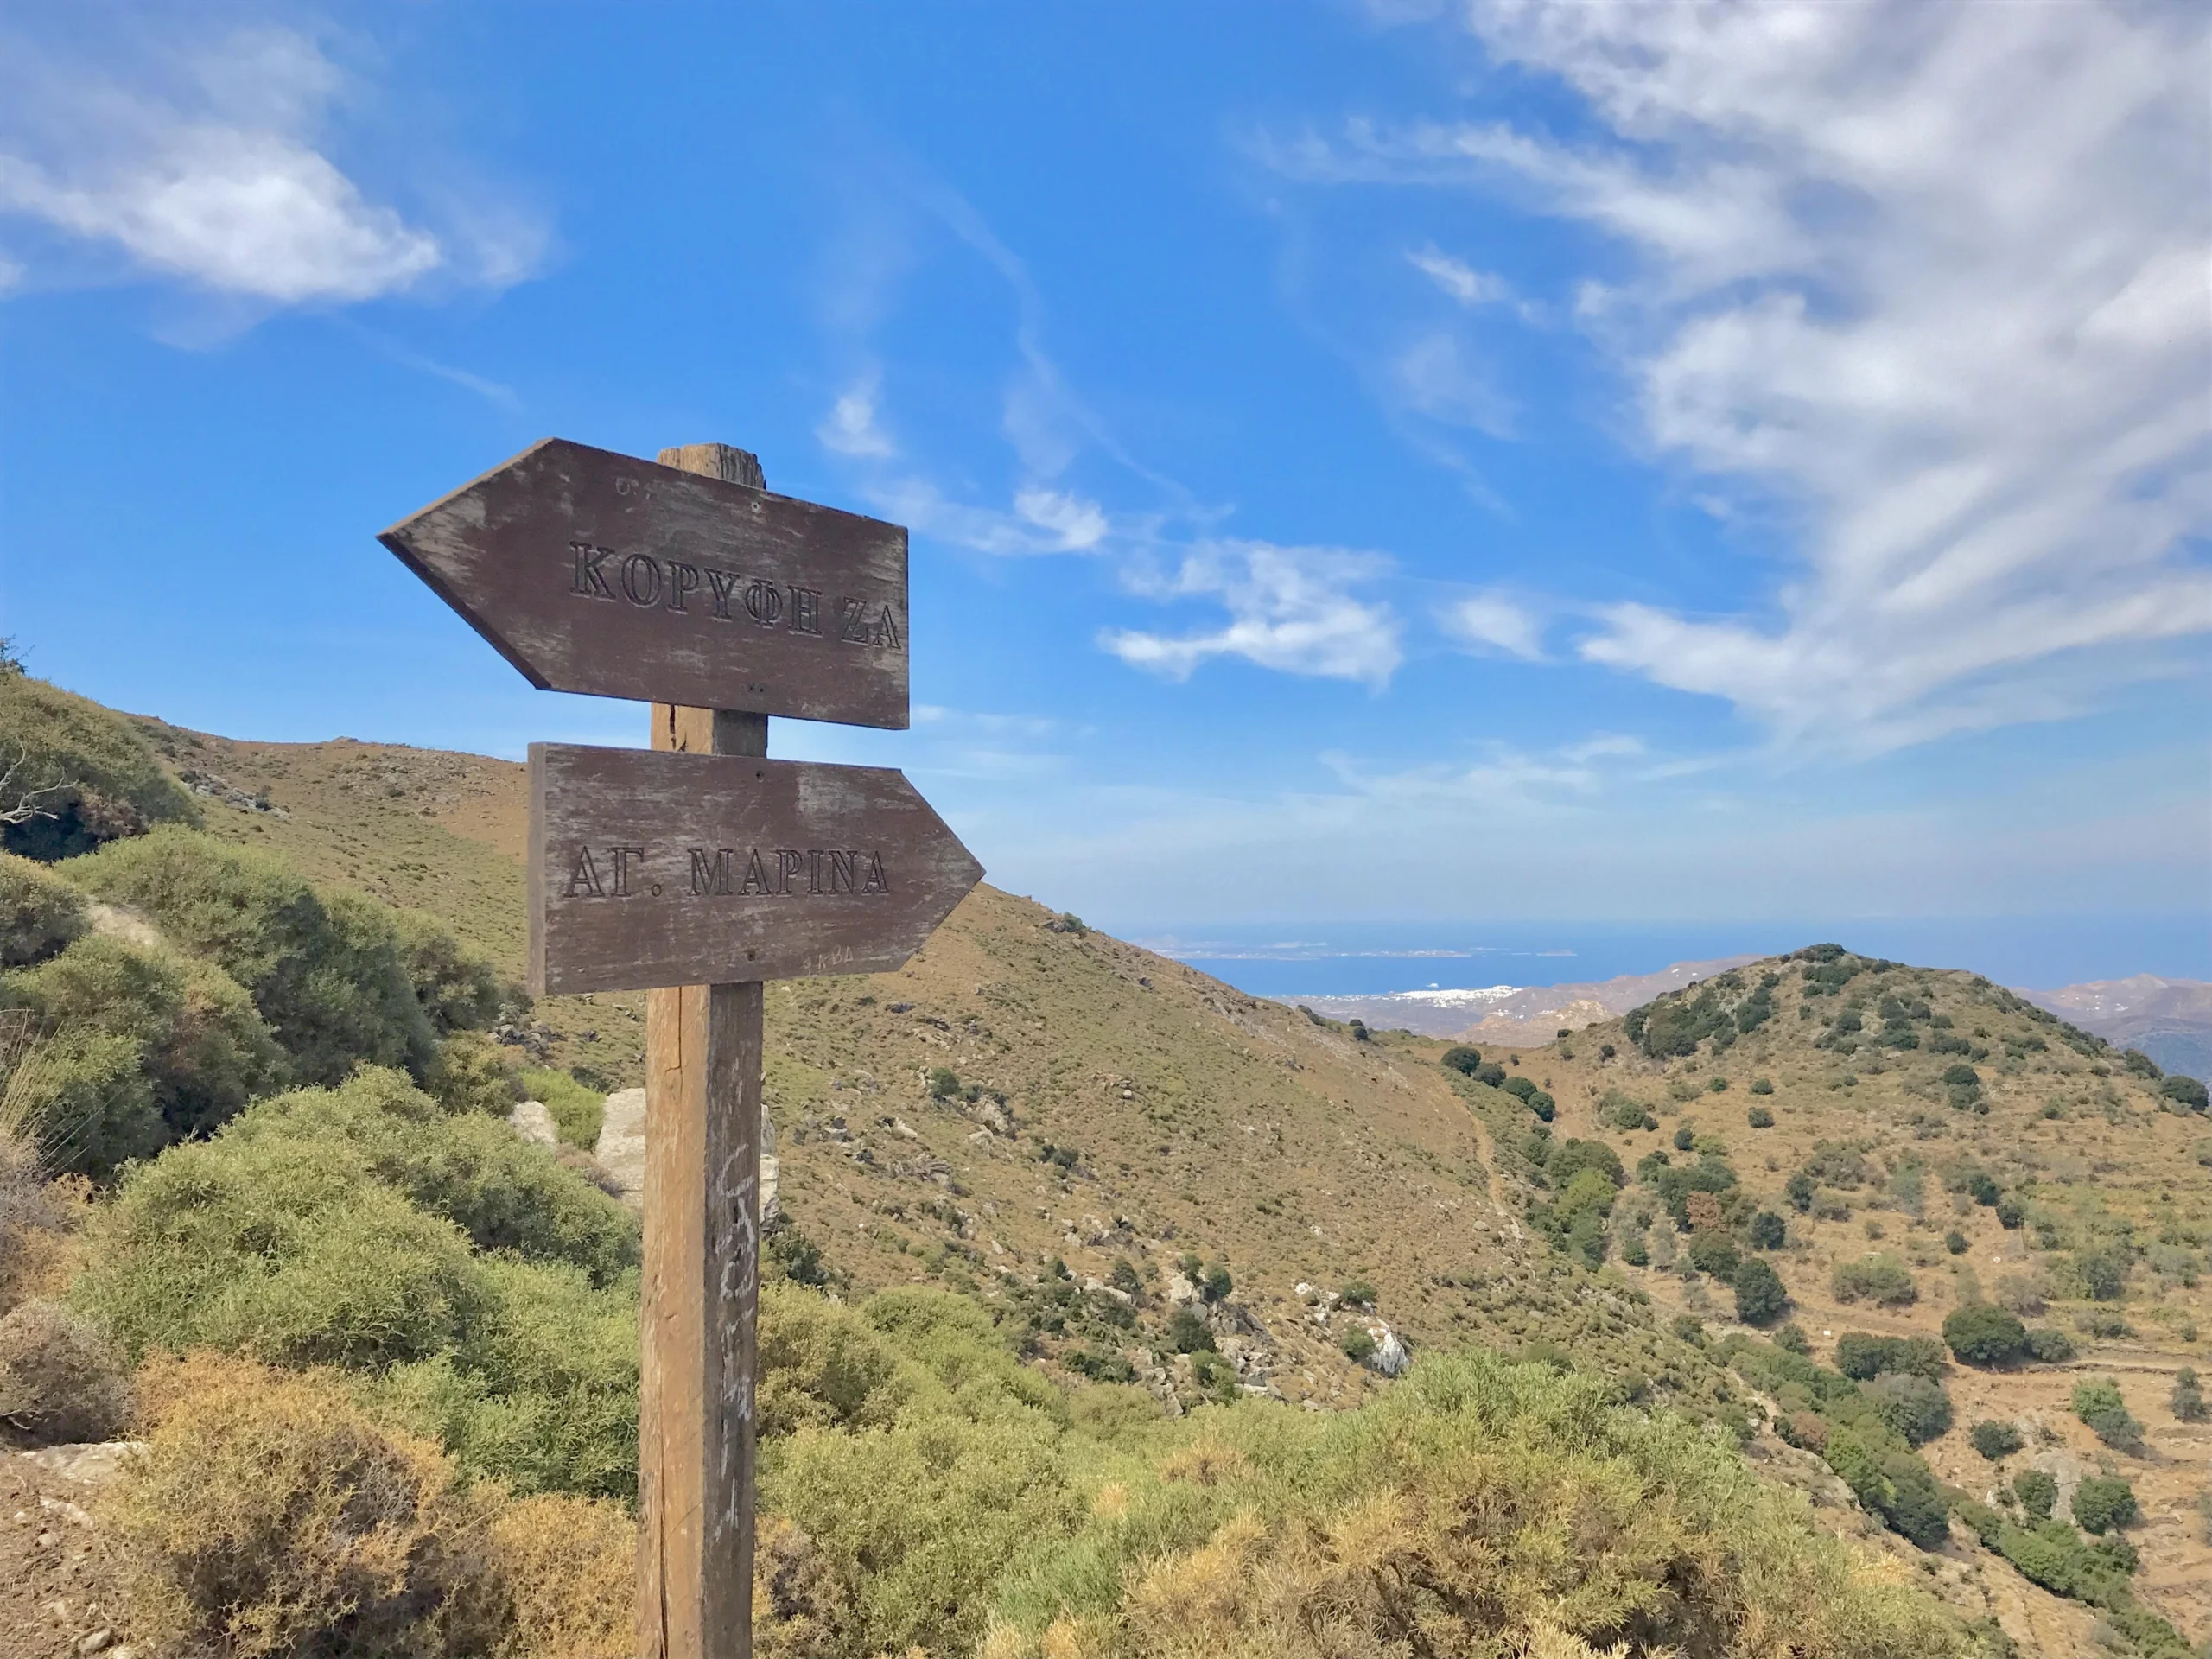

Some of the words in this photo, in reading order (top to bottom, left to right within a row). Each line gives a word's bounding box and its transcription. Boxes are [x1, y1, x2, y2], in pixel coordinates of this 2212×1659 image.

[569, 541, 824, 638] ΚΟΡΥΦΗ
[841, 595, 902, 651] ΖΑ
[563, 845, 663, 899] ΑΓ.
[687, 847, 891, 897] ΜΑΡΙΝΑ
